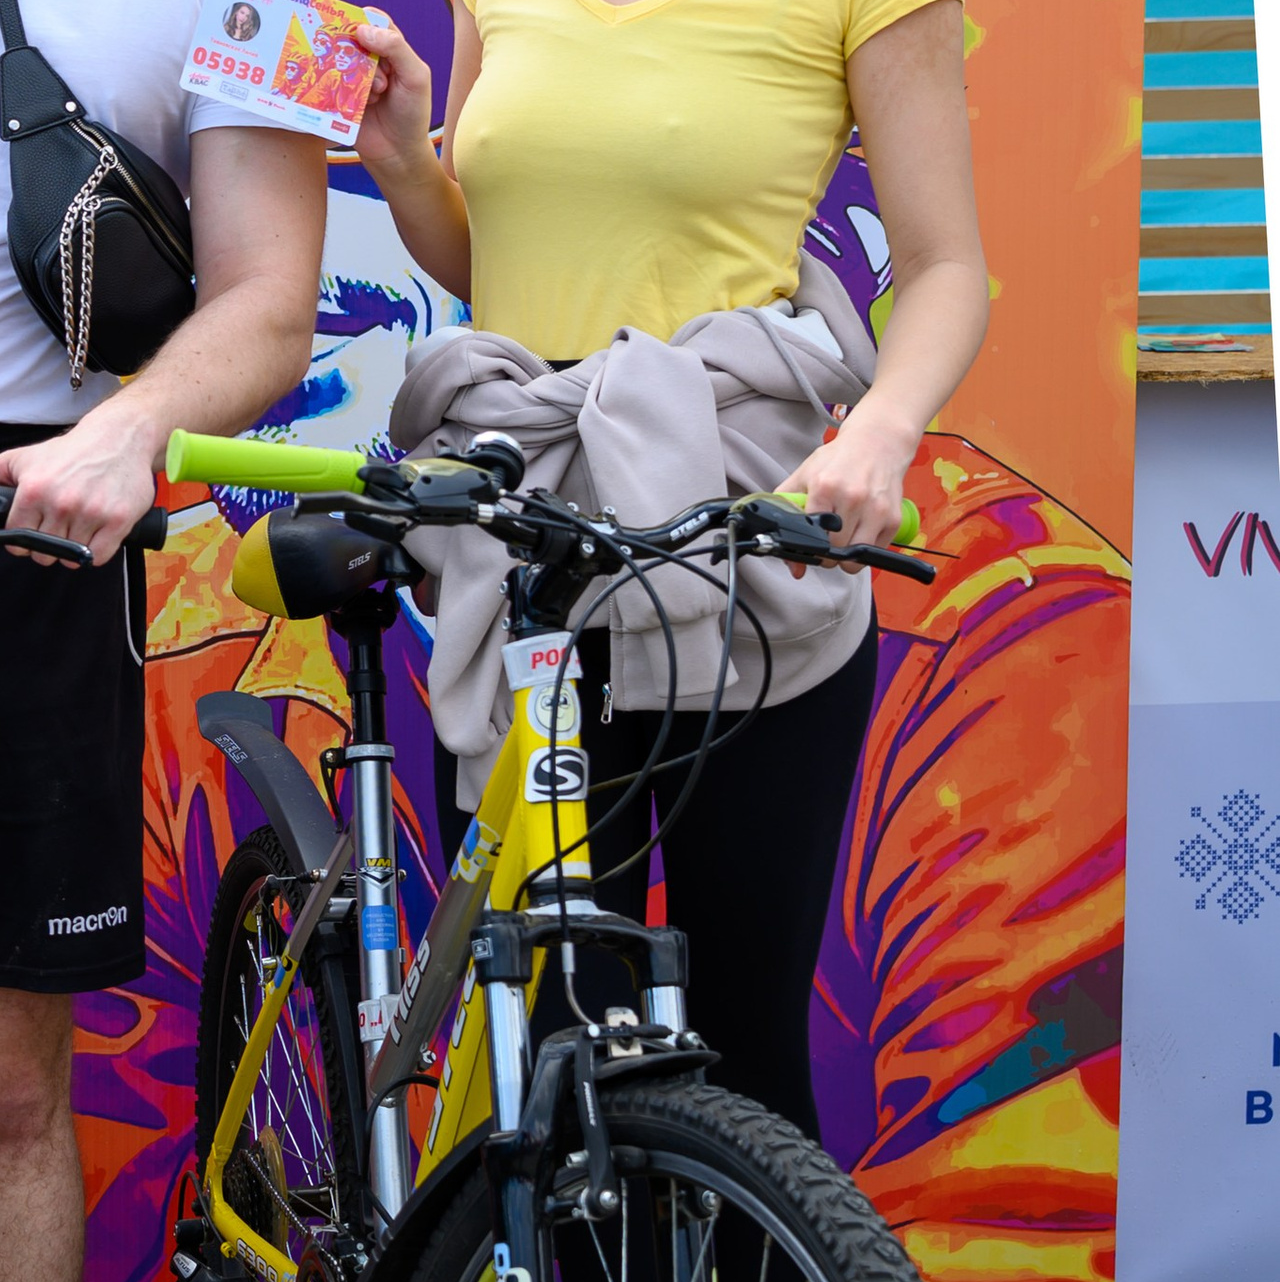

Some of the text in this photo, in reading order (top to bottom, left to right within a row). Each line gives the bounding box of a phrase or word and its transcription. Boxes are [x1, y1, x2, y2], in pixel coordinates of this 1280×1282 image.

[192, 46, 266, 85] 05938
[348, 551, 372, 570] STELS
[214, 733, 249, 764] STELS
[366, 858, 392, 867] VM
[48, 906, 127, 935] macron
